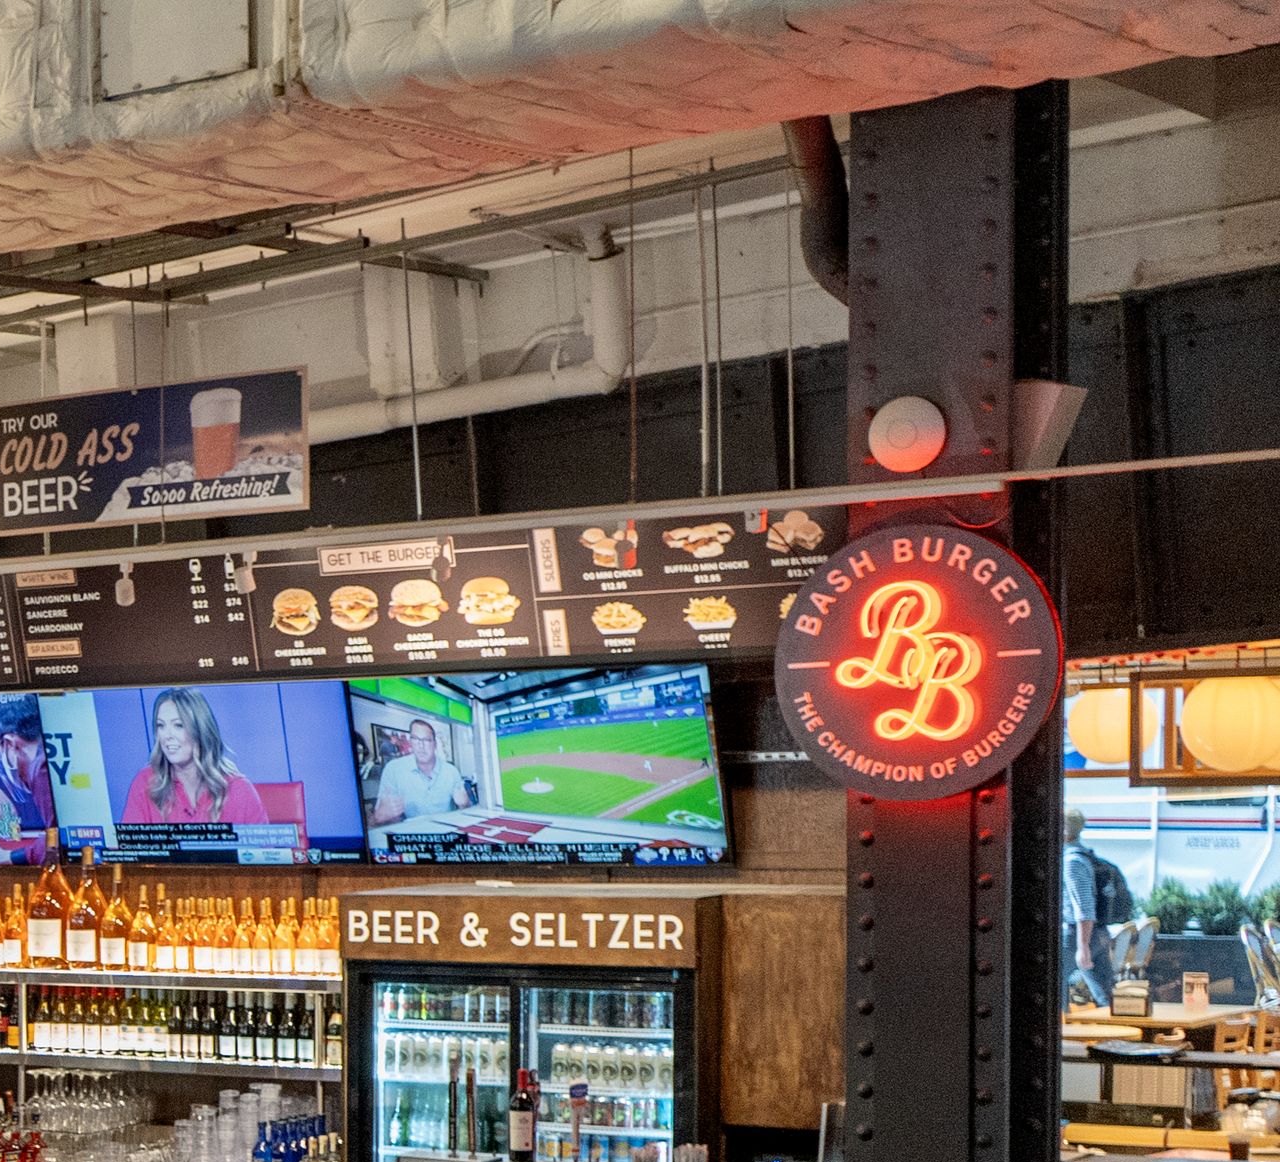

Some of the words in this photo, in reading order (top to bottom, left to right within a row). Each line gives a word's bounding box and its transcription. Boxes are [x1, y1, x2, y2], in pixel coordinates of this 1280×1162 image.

[1, 416, 24, 434] TRY
[30, 412, 58, 431] OUR
[0, 431, 68, 476] COLD
[77, 422, 140, 467] ASS
[190, 474, 277, 502] Refreshing!
[3, 475, 78, 518] BEER
[327, 552, 353, 567] GET
[359, 550, 383, 565] THE
[545, 538, 556, 582] SLIDERS
[664, 563, 692, 574] BUFFALO
[693, 562, 712, 573] MINI
[713, 560, 750, 571] CHICKS
[21, 573, 45, 582] WHITE
[49, 572, 68, 581] WINE
[597, 570, 613, 580] MINI
[613, 568, 643, 579] CHICKS
[794, 550, 877, 637] BASH
[892, 536, 1032, 625] BURGER
[24, 594, 71, 605] SAUVIGNON
[72, 592, 100, 602] BLANC
[26, 609, 68, 620] SANCERRE
[192, 600, 208, 609] $22
[28, 622, 83, 633] CHARDONNAY
[552, 619, 563, 649] FRIES
[456, 639, 489, 648] CHICKEN
[489, 636, 529, 647] SANDWICH
[604, 637, 635, 648] FRENCH
[698, 632, 731, 644] CHEESY
[30, 643, 75, 654] SPARKLING
[35, 664, 79, 675] PROSECCO
[793, 691, 825, 732] THE
[817, 730, 924, 782] CHAMPION
[930, 756, 958, 779] OF
[961, 682, 1037, 767] BURGERS
[117, 824, 178, 832] Unfortunately,
[185, 823, 205, 831] don't
[170, 833, 205, 841] January
[394, 844, 443, 852] WHAT'S
[450, 844, 489, 852] JUDGE
[502, 843, 559, 851] TELLING
[566, 843, 637, 851] HIMSELF?
[347, 909, 440, 945] BEER
[460, 911, 489, 948] &
[509, 912, 685, 950] SELTZER
